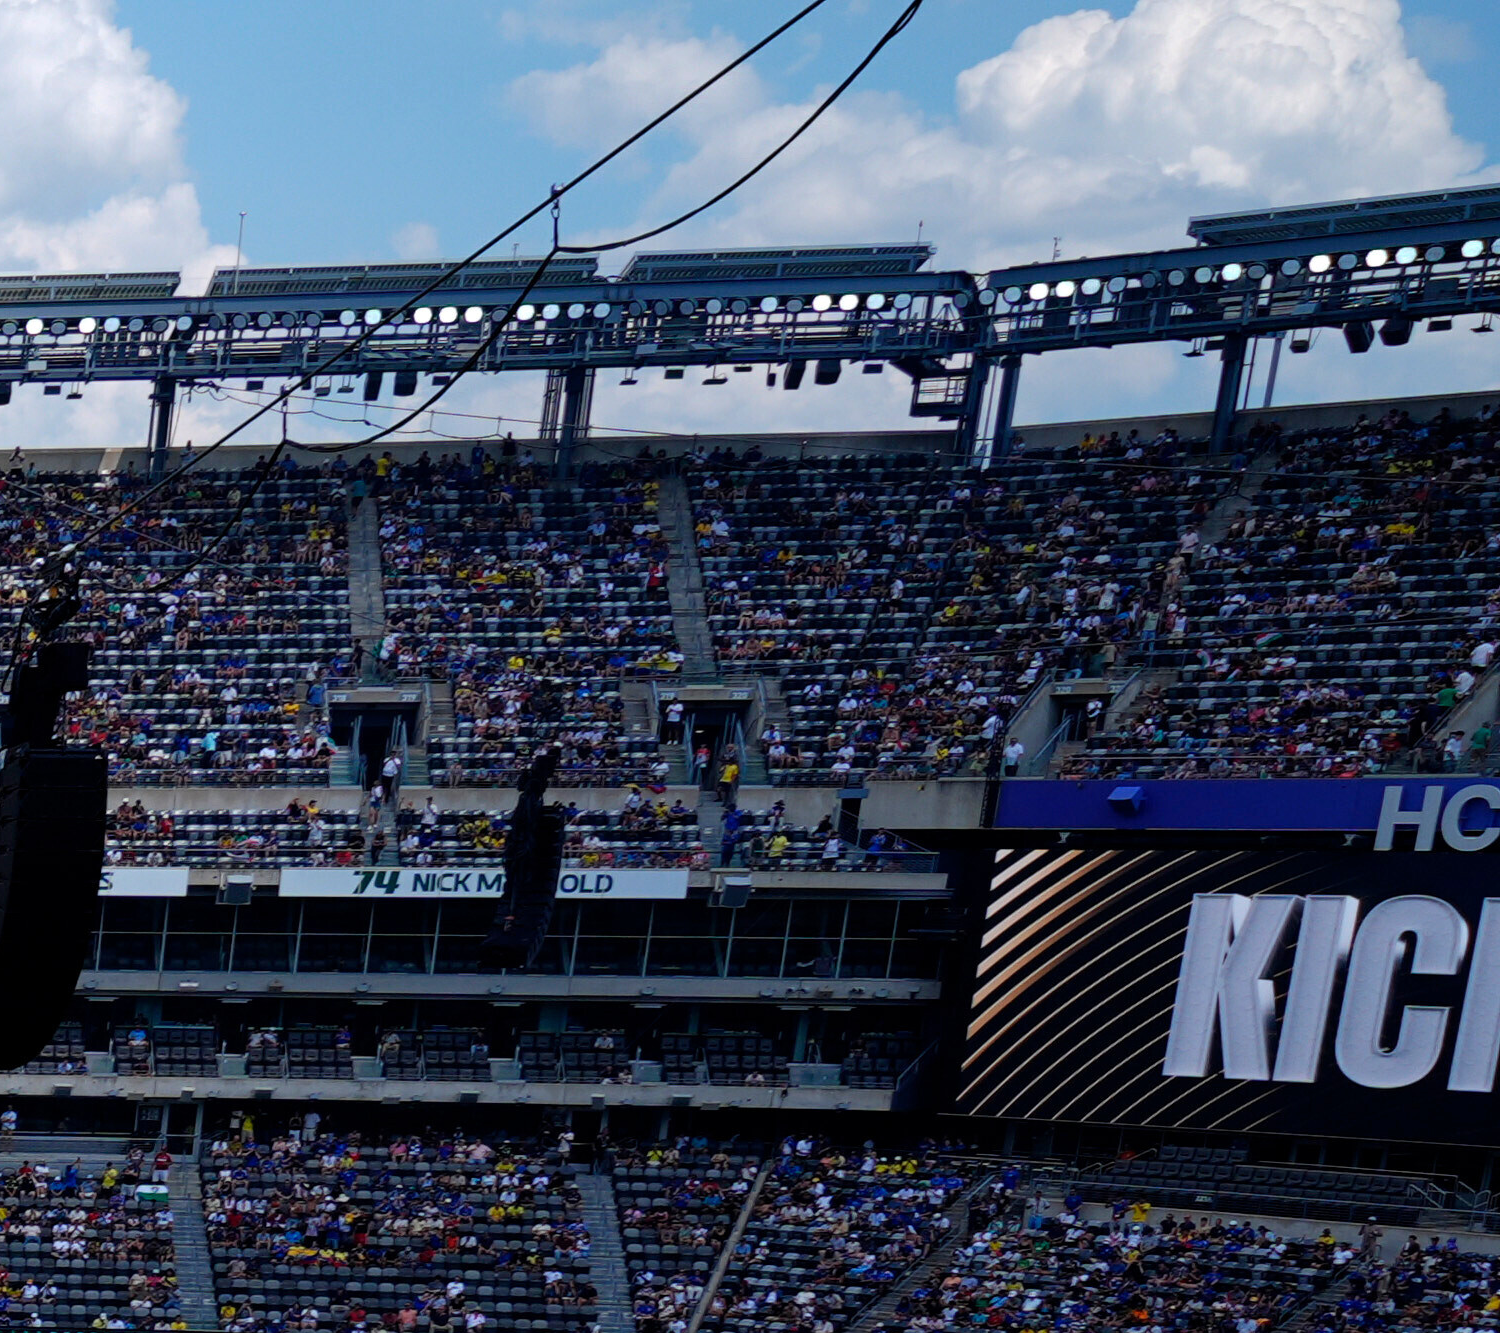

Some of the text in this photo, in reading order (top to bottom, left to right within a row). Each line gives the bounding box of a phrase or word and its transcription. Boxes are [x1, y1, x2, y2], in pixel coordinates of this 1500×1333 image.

[352, 870, 614, 894] 74 NICK MOLD
